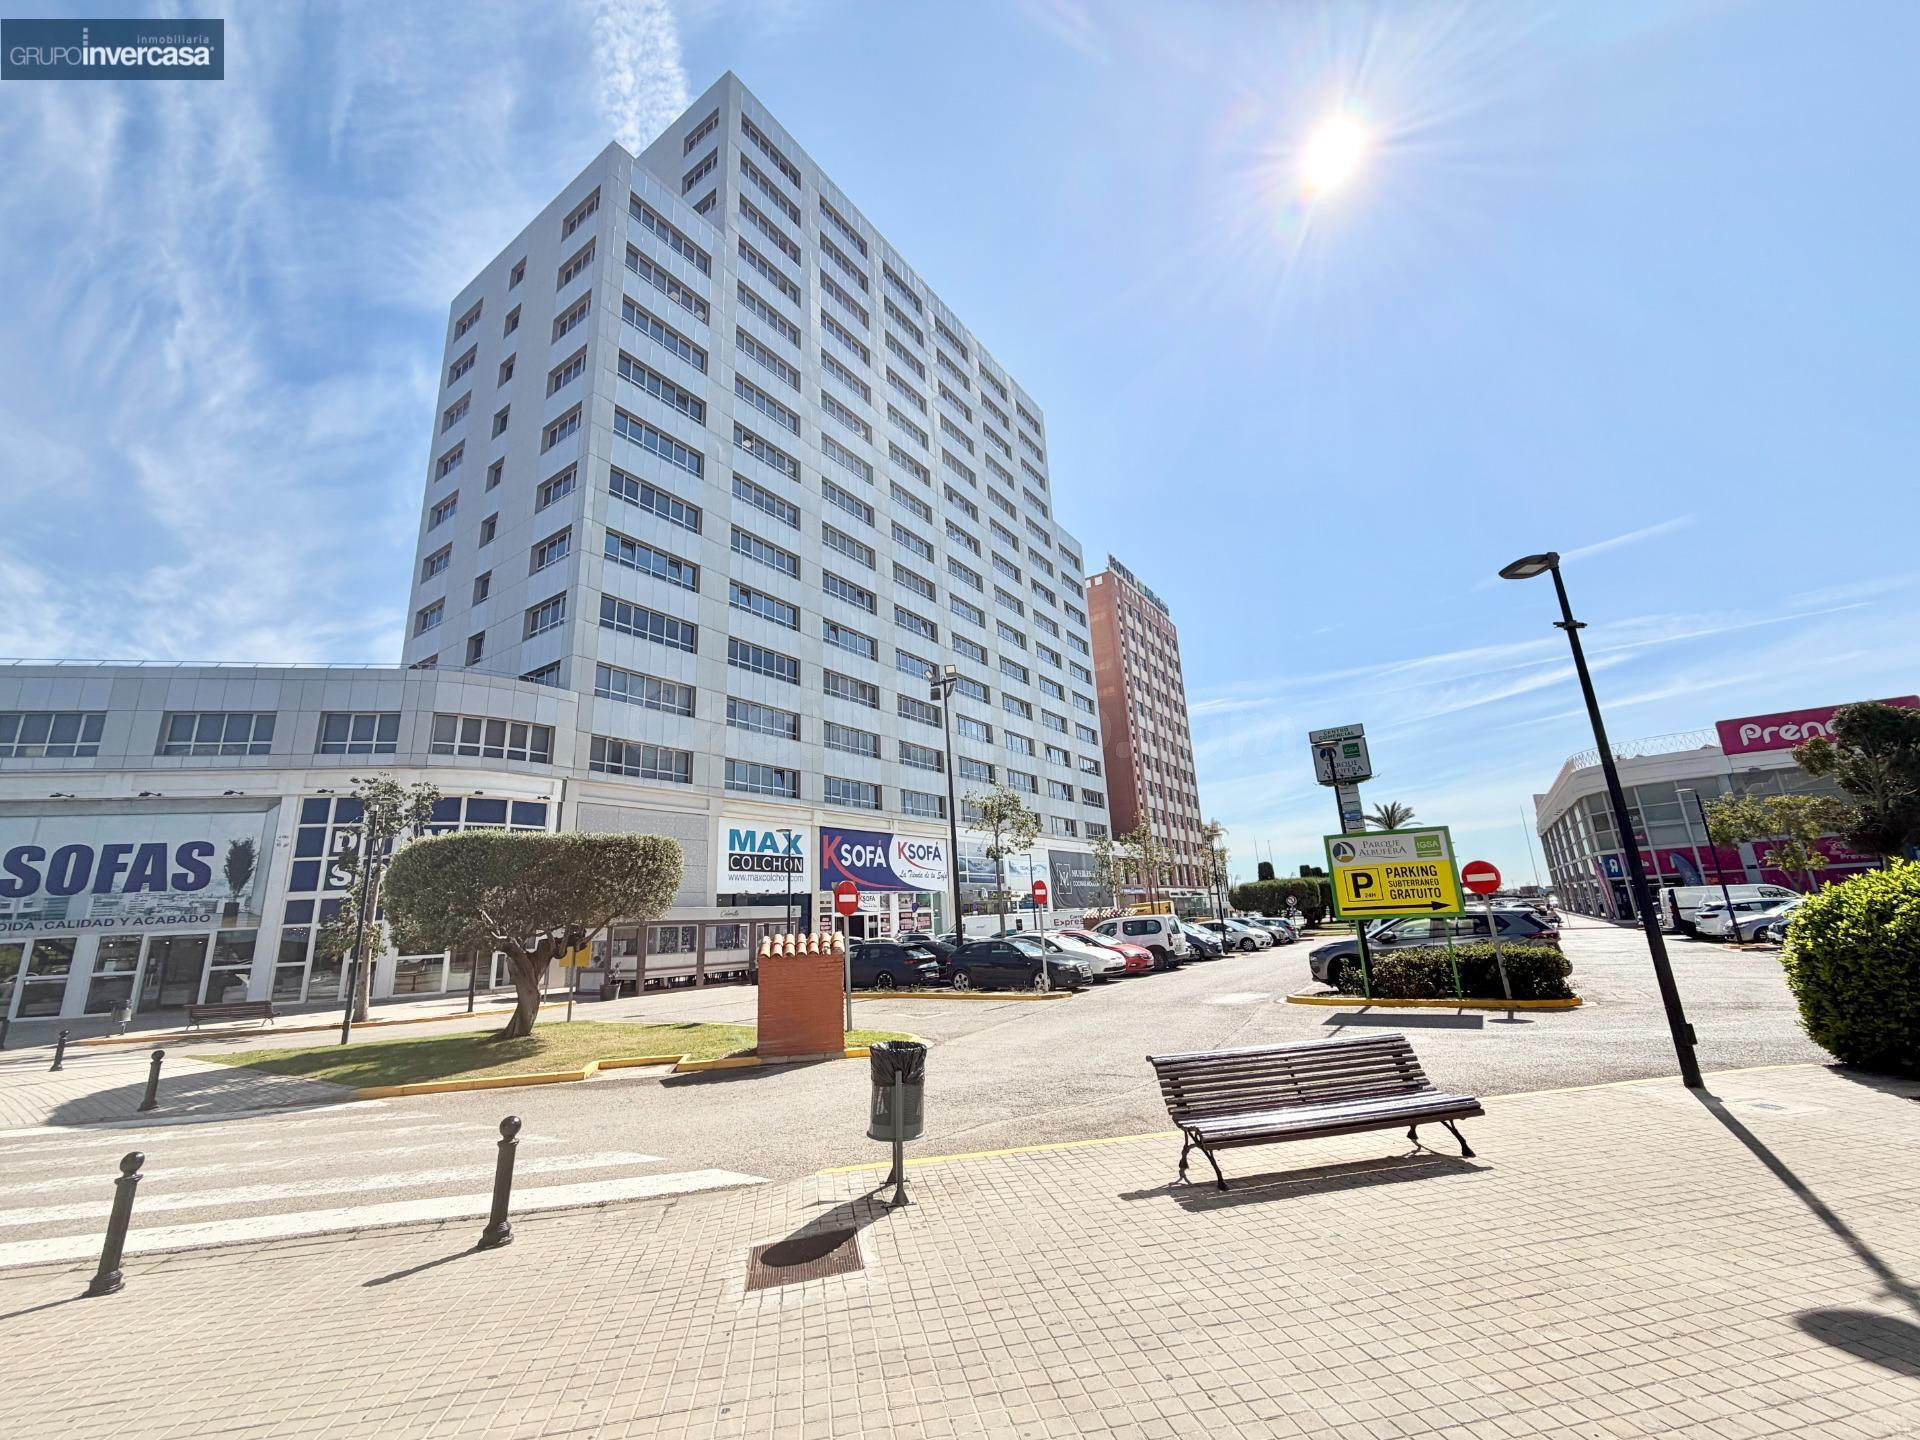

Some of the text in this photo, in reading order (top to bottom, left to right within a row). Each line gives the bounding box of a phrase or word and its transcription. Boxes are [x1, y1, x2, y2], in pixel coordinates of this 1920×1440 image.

[1318, 731, 1354, 740] COMERCIAL
[1323, 727, 1349, 736] CENTRO
[729, 829, 803, 855] MAX
[1362, 839, 1400, 849] PARQUE
[1417, 840, 1440, 849] IGSA
[1358, 847, 1408, 857] ALBUFERA
[0, 841, 215, 898] SOFAS
[730, 855, 803, 872] COLCHON
[1385, 865, 1438, 879] PARKING
[1351, 872, 1374, 899] P
[1389, 887, 1441, 900] GRATUITO
[119, 917, 130, 926] Y
[133, 914, 210, 925] ACABADO
